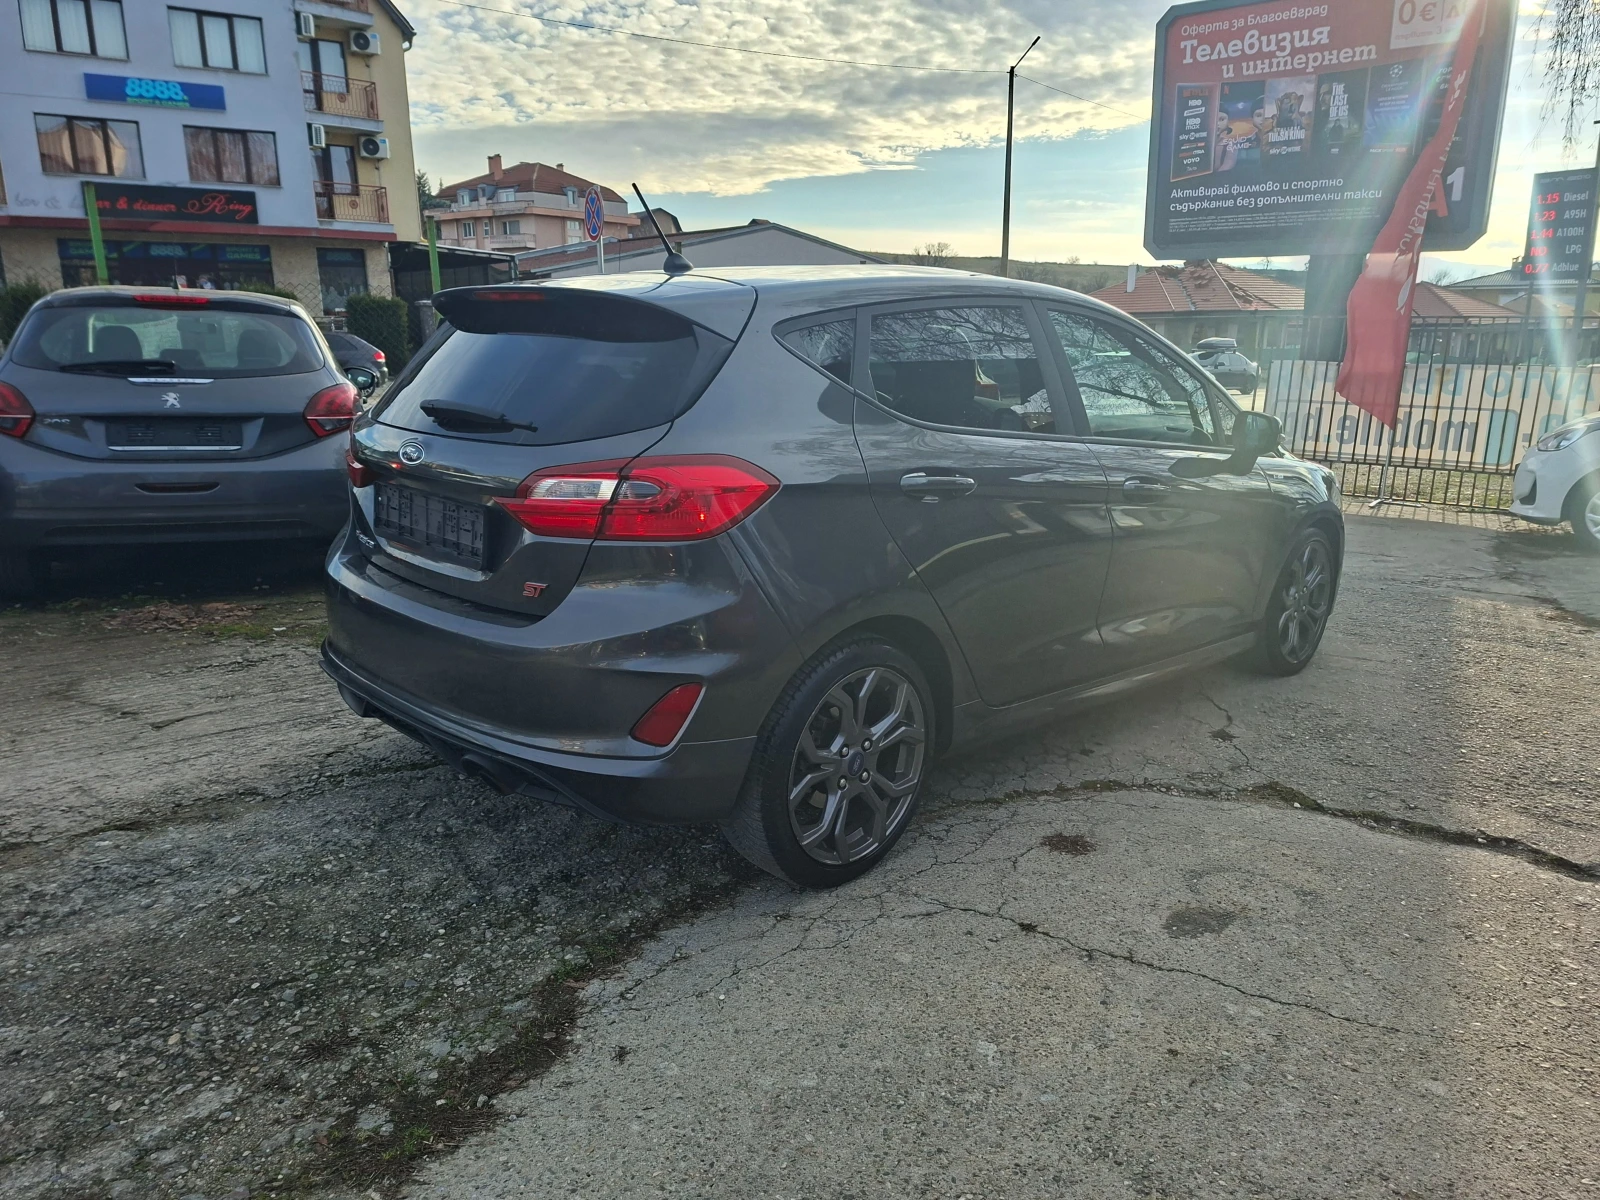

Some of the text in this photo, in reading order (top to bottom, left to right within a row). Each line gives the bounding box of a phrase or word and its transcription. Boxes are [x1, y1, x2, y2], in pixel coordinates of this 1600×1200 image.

[1181, 5, 1328, 37] Оферта за Благоевград
[1180, 26, 1330, 64] Телевизия
[1222, 44, 1377, 78] и интернет
[1332, 83, 1345, 95] THE
[1330, 94, 1348, 106] LAST
[1171, 178, 1344, 199] Активирай филмово и спортно
[1170, 189, 1382, 213] съдържание без допълнителни такси
[1536, 191, 1589, 204] 1.15 Diesel
[1563, 209, 1587, 219] A95H
[1556, 226, 1585, 237] A100H
[1565, 244, 1582, 254] LPG
[1552, 262, 1579, 272] Adblue
[522, 582, 548, 598] ST
